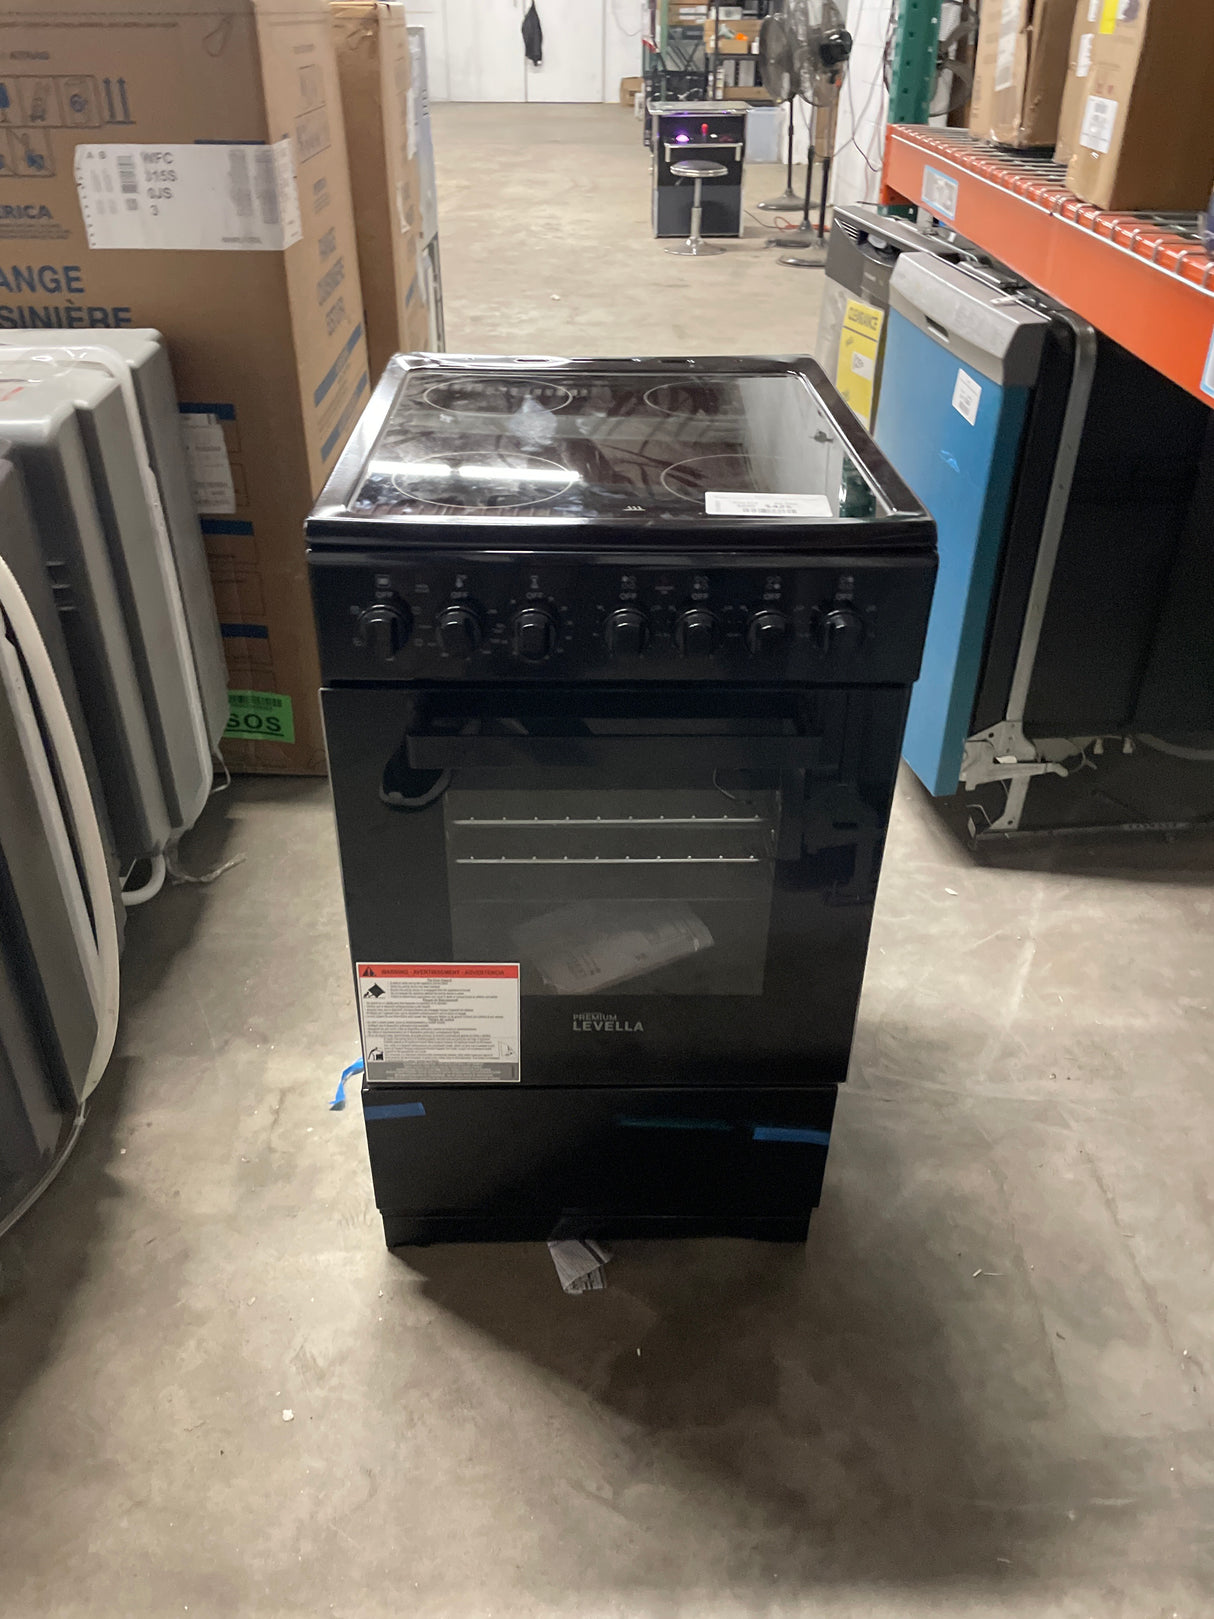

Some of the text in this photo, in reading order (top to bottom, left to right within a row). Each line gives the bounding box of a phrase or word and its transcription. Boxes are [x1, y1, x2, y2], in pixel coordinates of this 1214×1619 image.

[0, 204, 53, 219] RICA
[573, 1013, 617, 1021] PREMIUM
[573, 1021, 644, 1031] LEVELLA
